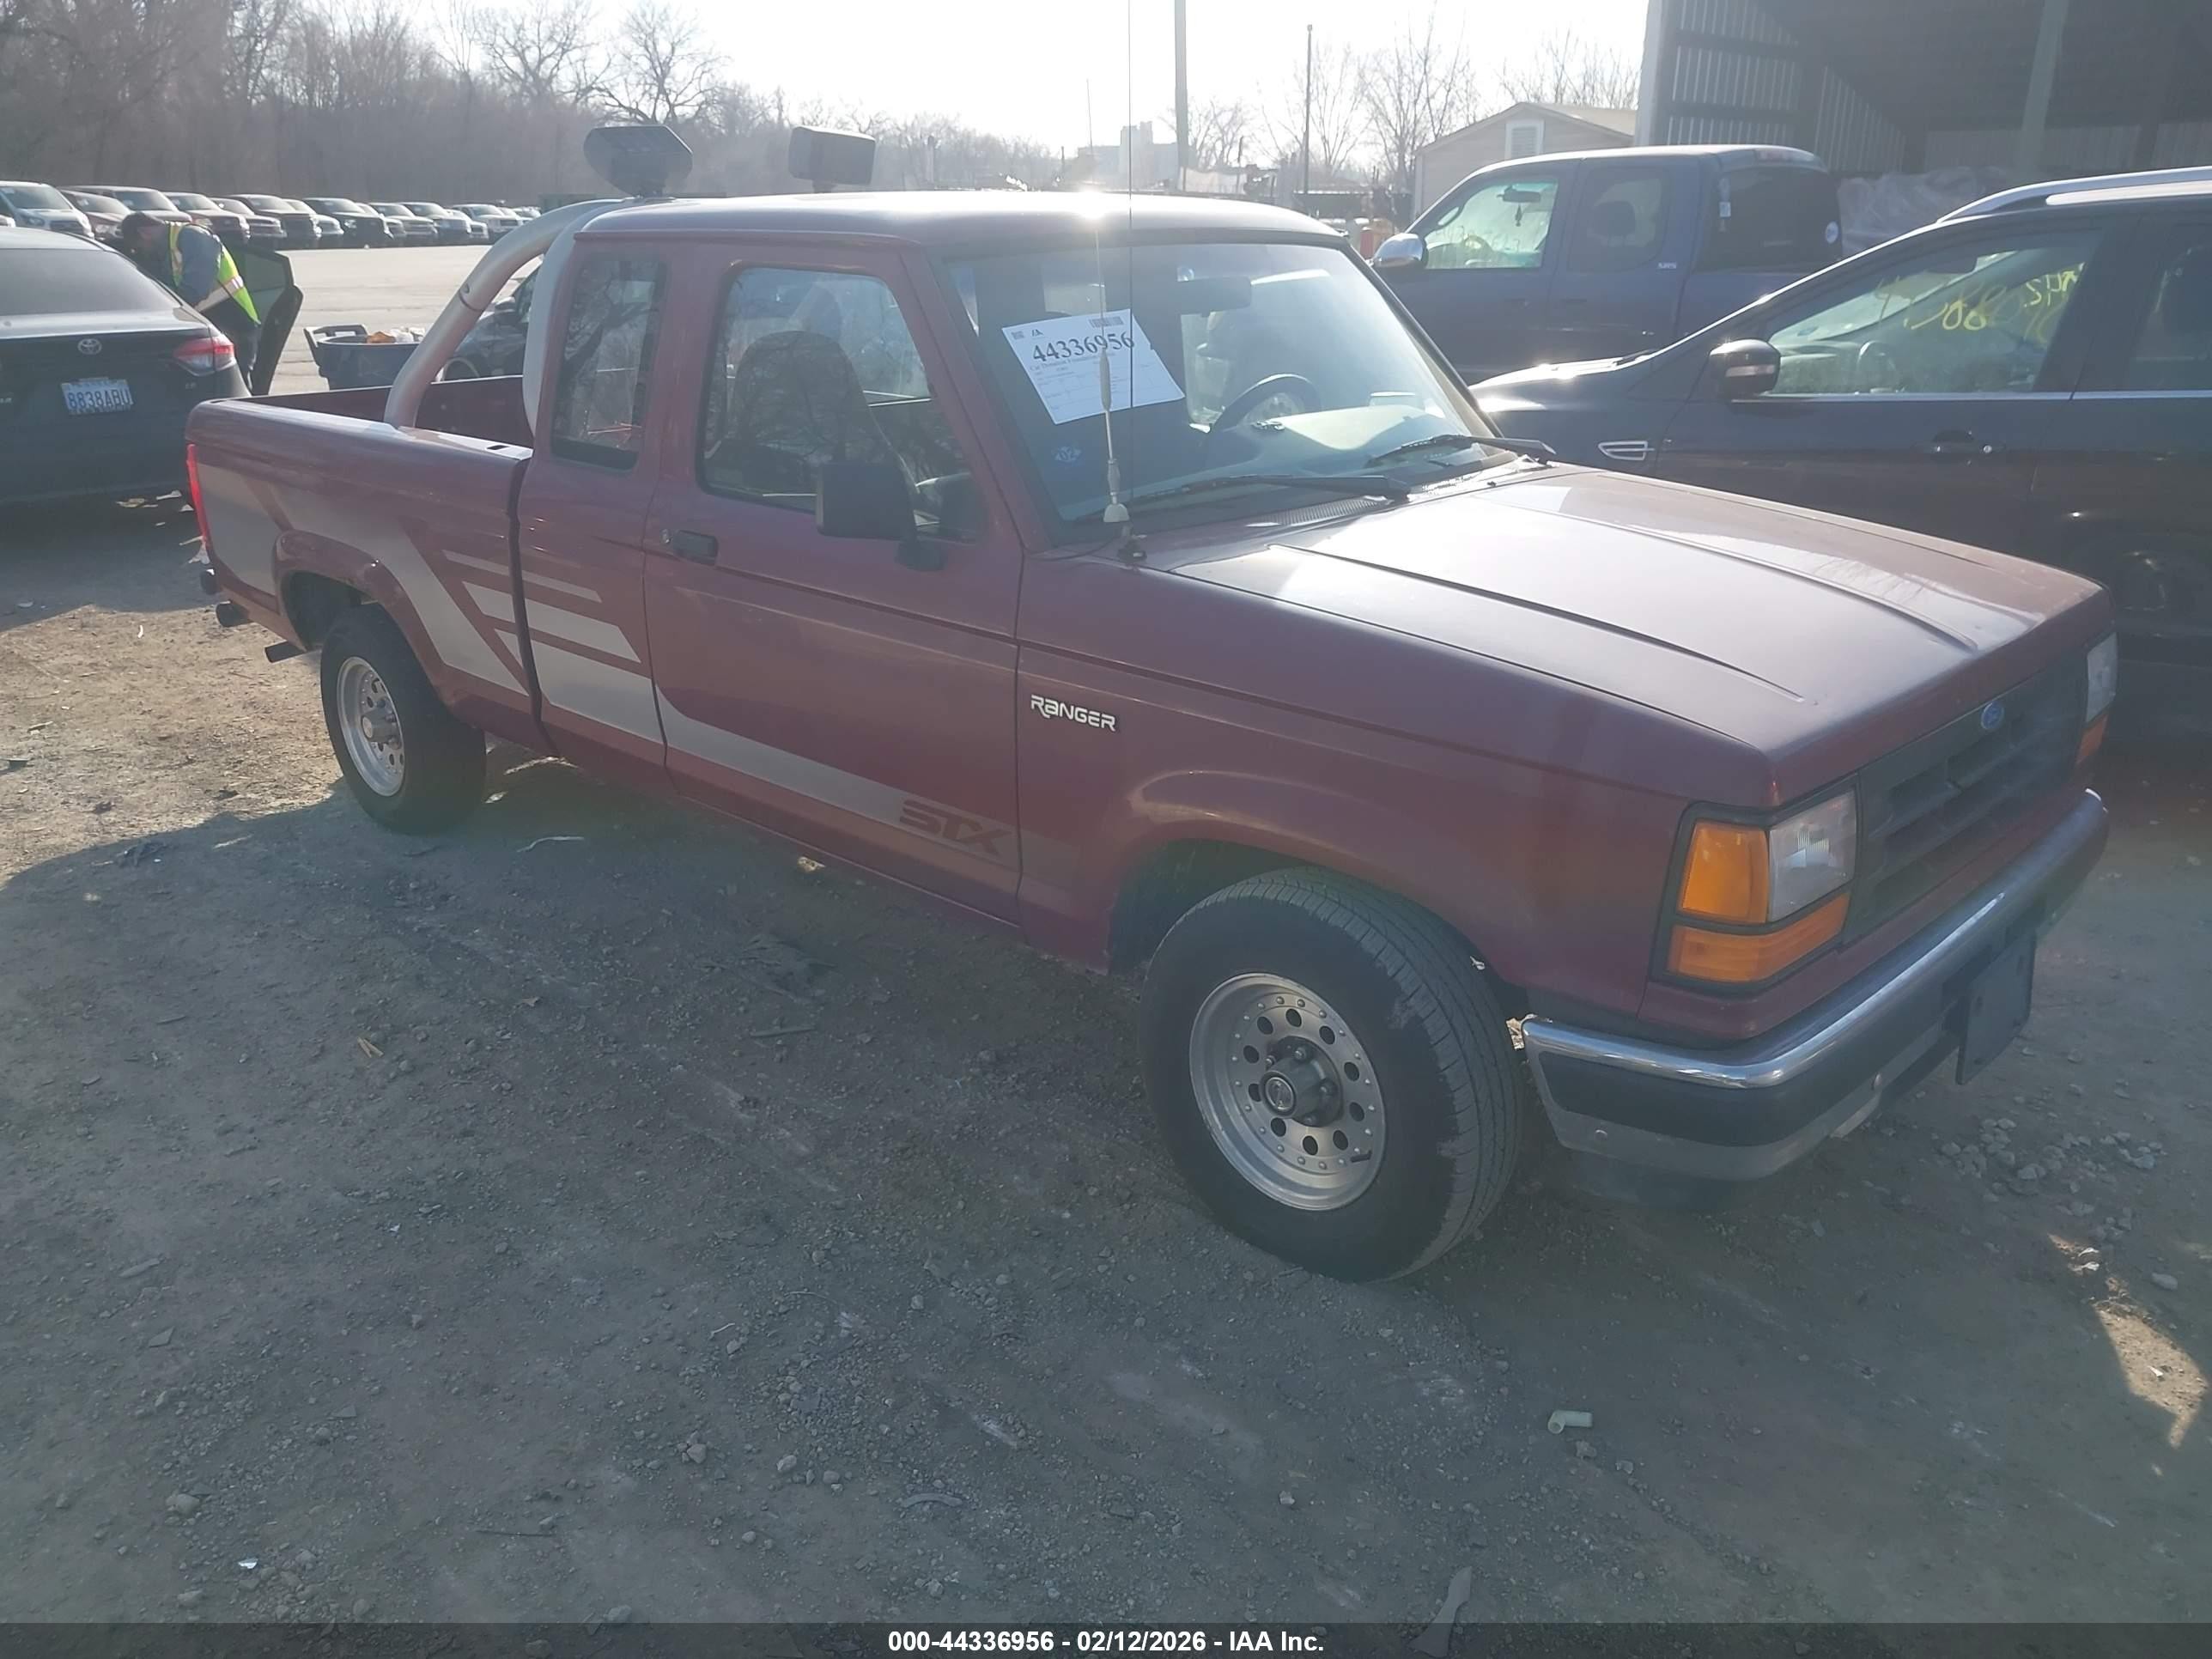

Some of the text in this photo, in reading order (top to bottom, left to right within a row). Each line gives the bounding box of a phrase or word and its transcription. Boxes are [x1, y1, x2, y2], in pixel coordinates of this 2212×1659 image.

[1033, 331, 1134, 362] 44336956
[68, 389, 131, 409] 8838ABU
[1030, 694, 1116, 732] RANGER
[900, 799, 1013, 856] STX
